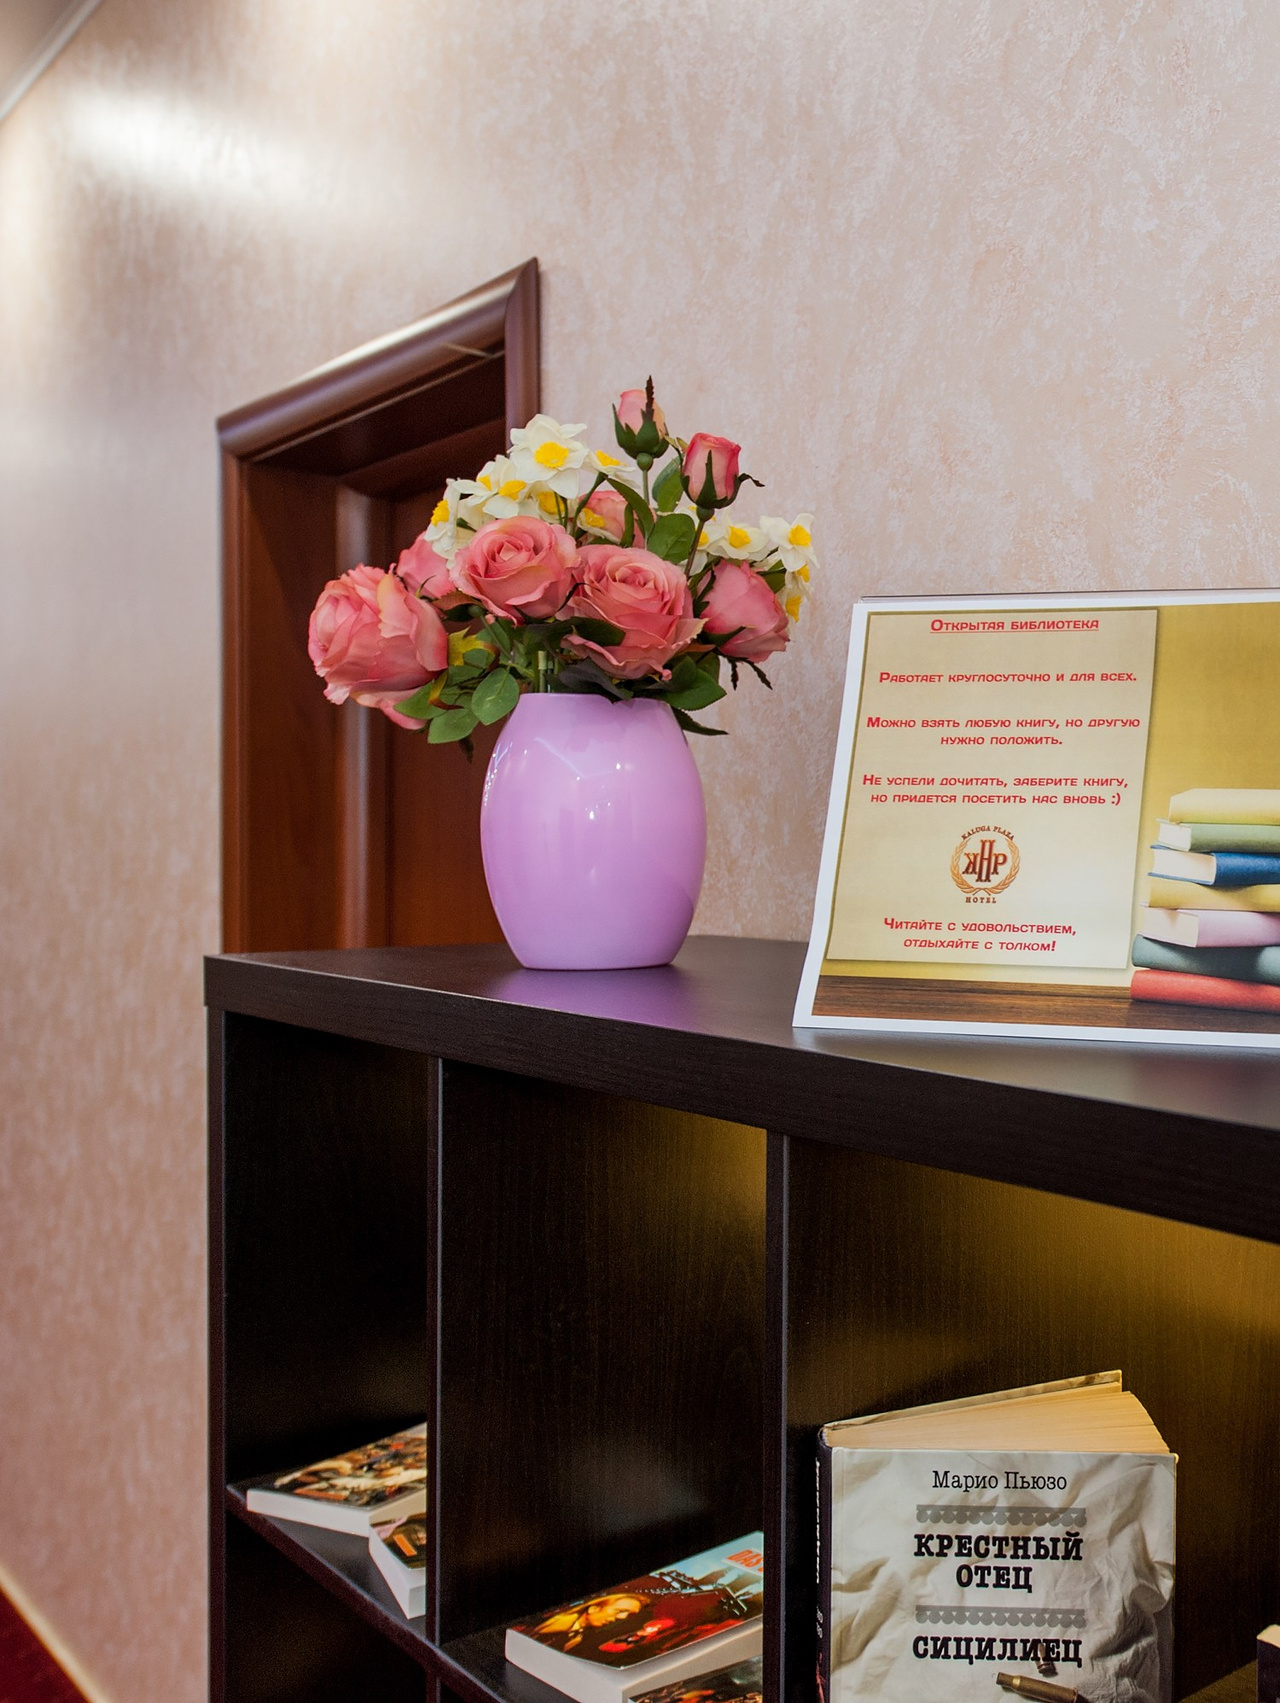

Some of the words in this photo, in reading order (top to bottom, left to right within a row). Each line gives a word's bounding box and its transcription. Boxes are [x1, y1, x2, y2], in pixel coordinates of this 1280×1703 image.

[961, 825, 991, 841] KALUGA
[992, 826, 1015, 841] PLAZA
[965, 896, 997, 904] HOTEL
[932, 1470, 999, 1493] Марио
[1004, 1471, 1067, 1490] Пьюзо
[913, 1531, 1083, 1561] КРЕСТНЫЙ
[956, 1564, 1033, 1593] ОТЕЦ
[913, 1635, 1082, 1668] СИЦИЛИЕЦ
